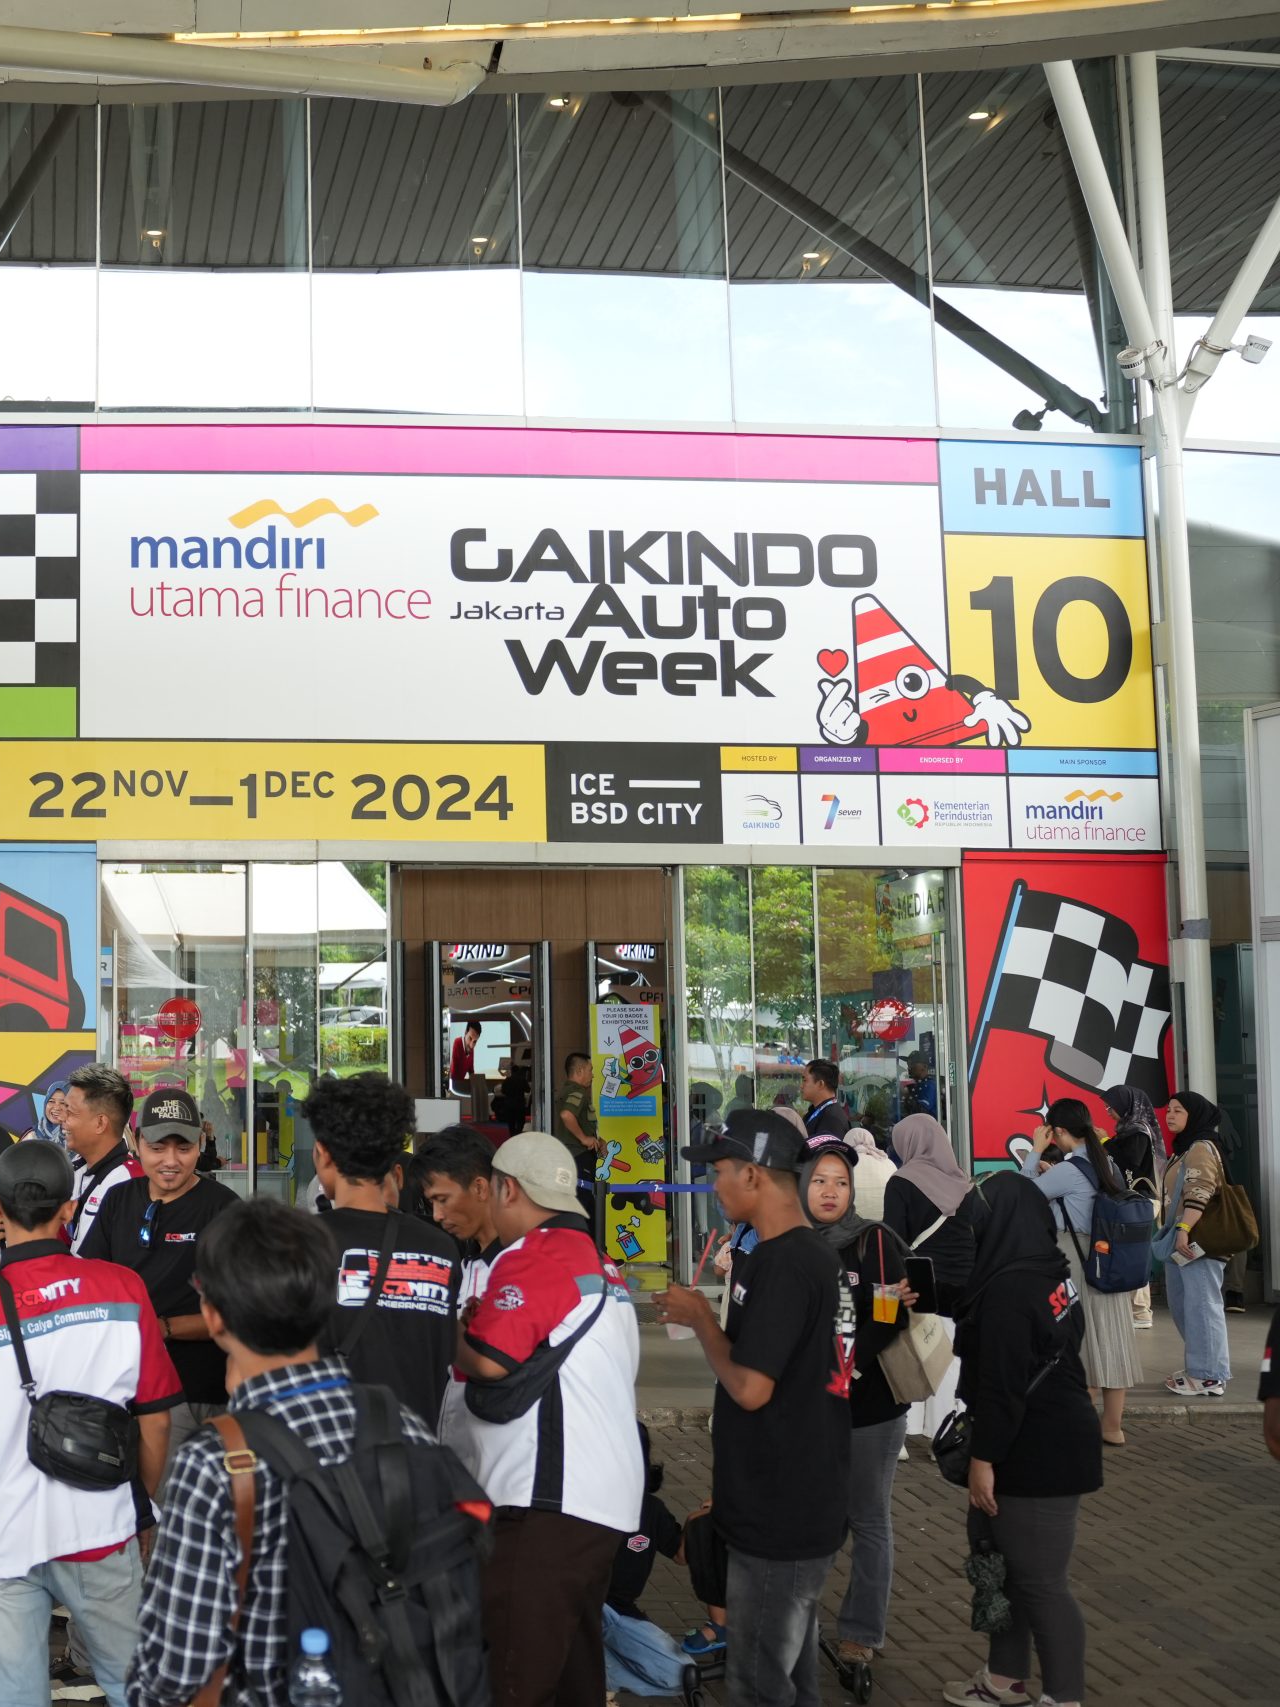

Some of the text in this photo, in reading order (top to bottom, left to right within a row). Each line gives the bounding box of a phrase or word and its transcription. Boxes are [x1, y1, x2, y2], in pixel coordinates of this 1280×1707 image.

[974, 467, 1111, 508] HALL
[130, 525, 325, 569] mandiri
[450, 528, 878, 588] GAIKINDO
[130, 573, 432, 619] utama finance
[450, 583, 787, 641] Jakarta Auto
[970, 576, 1132, 703] 10
[504, 638, 777, 697] Week
[29, 771, 107, 818] 22
[114, 769, 188, 797] NOV
[240, 773, 257, 818] 1
[265, 770, 335, 798] DEC
[351, 774, 513, 821] 2024
[571, 773, 615, 795] ICE
[571, 802, 703, 825] BSD CITY
[934, 801, 990, 811] Kementerian
[934, 811, 993, 822] Perindustrian
[1026, 800, 1103, 820] mandiri
[742, 821, 780, 829] GAIKINDO
[1026, 820, 1146, 842] utama finance
[897, 890, 935, 920] MEDIA
[151, 1106, 179, 1114] NORTH
[368, 1249, 453, 1268] CAPTER
[54, 1307, 109, 1326] Community
